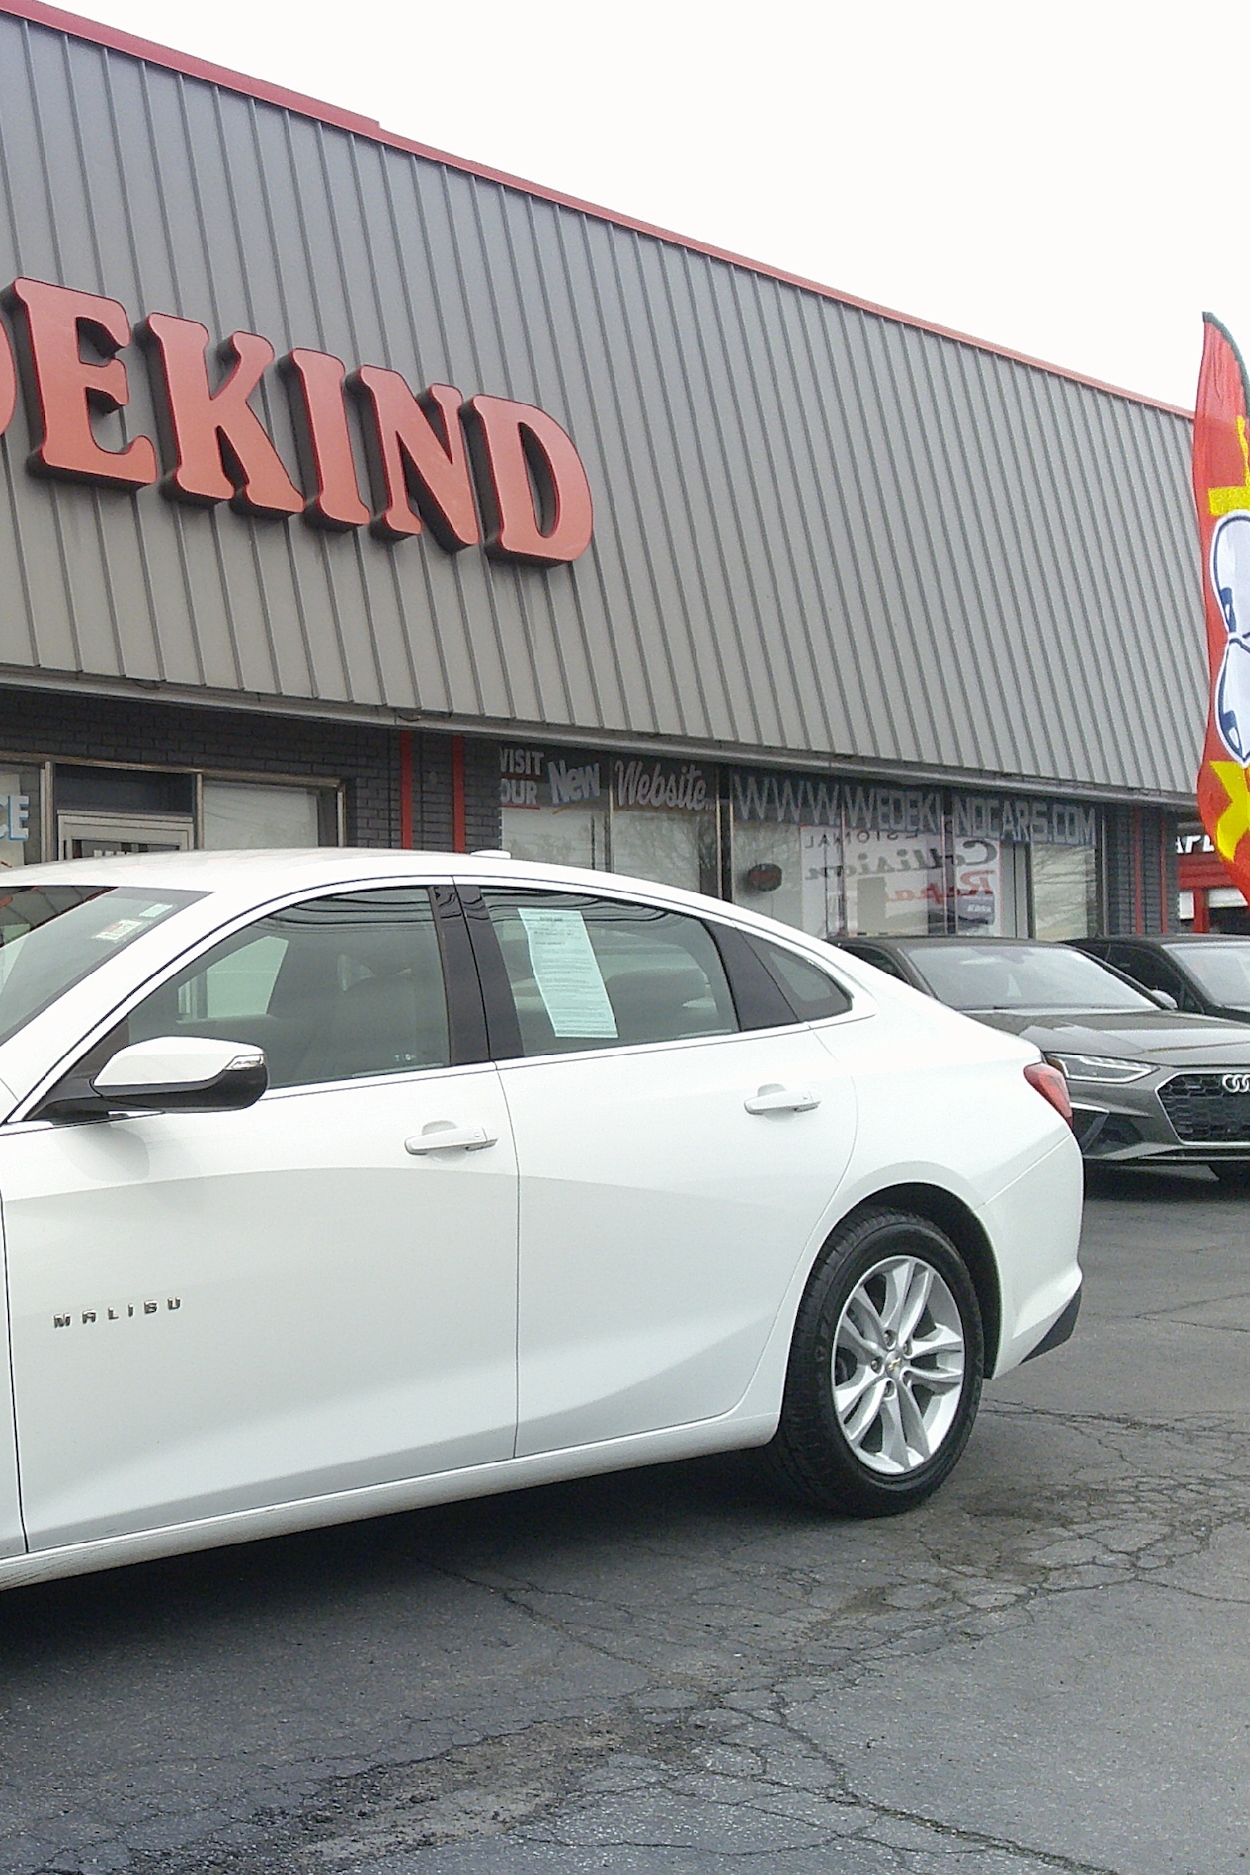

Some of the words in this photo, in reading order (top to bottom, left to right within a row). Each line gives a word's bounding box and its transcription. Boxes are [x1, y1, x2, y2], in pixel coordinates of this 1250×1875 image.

[500, 748, 545, 776] VISIT
[548, 759, 600, 804] New
[53, 1296, 182, 1329] MALIBU
